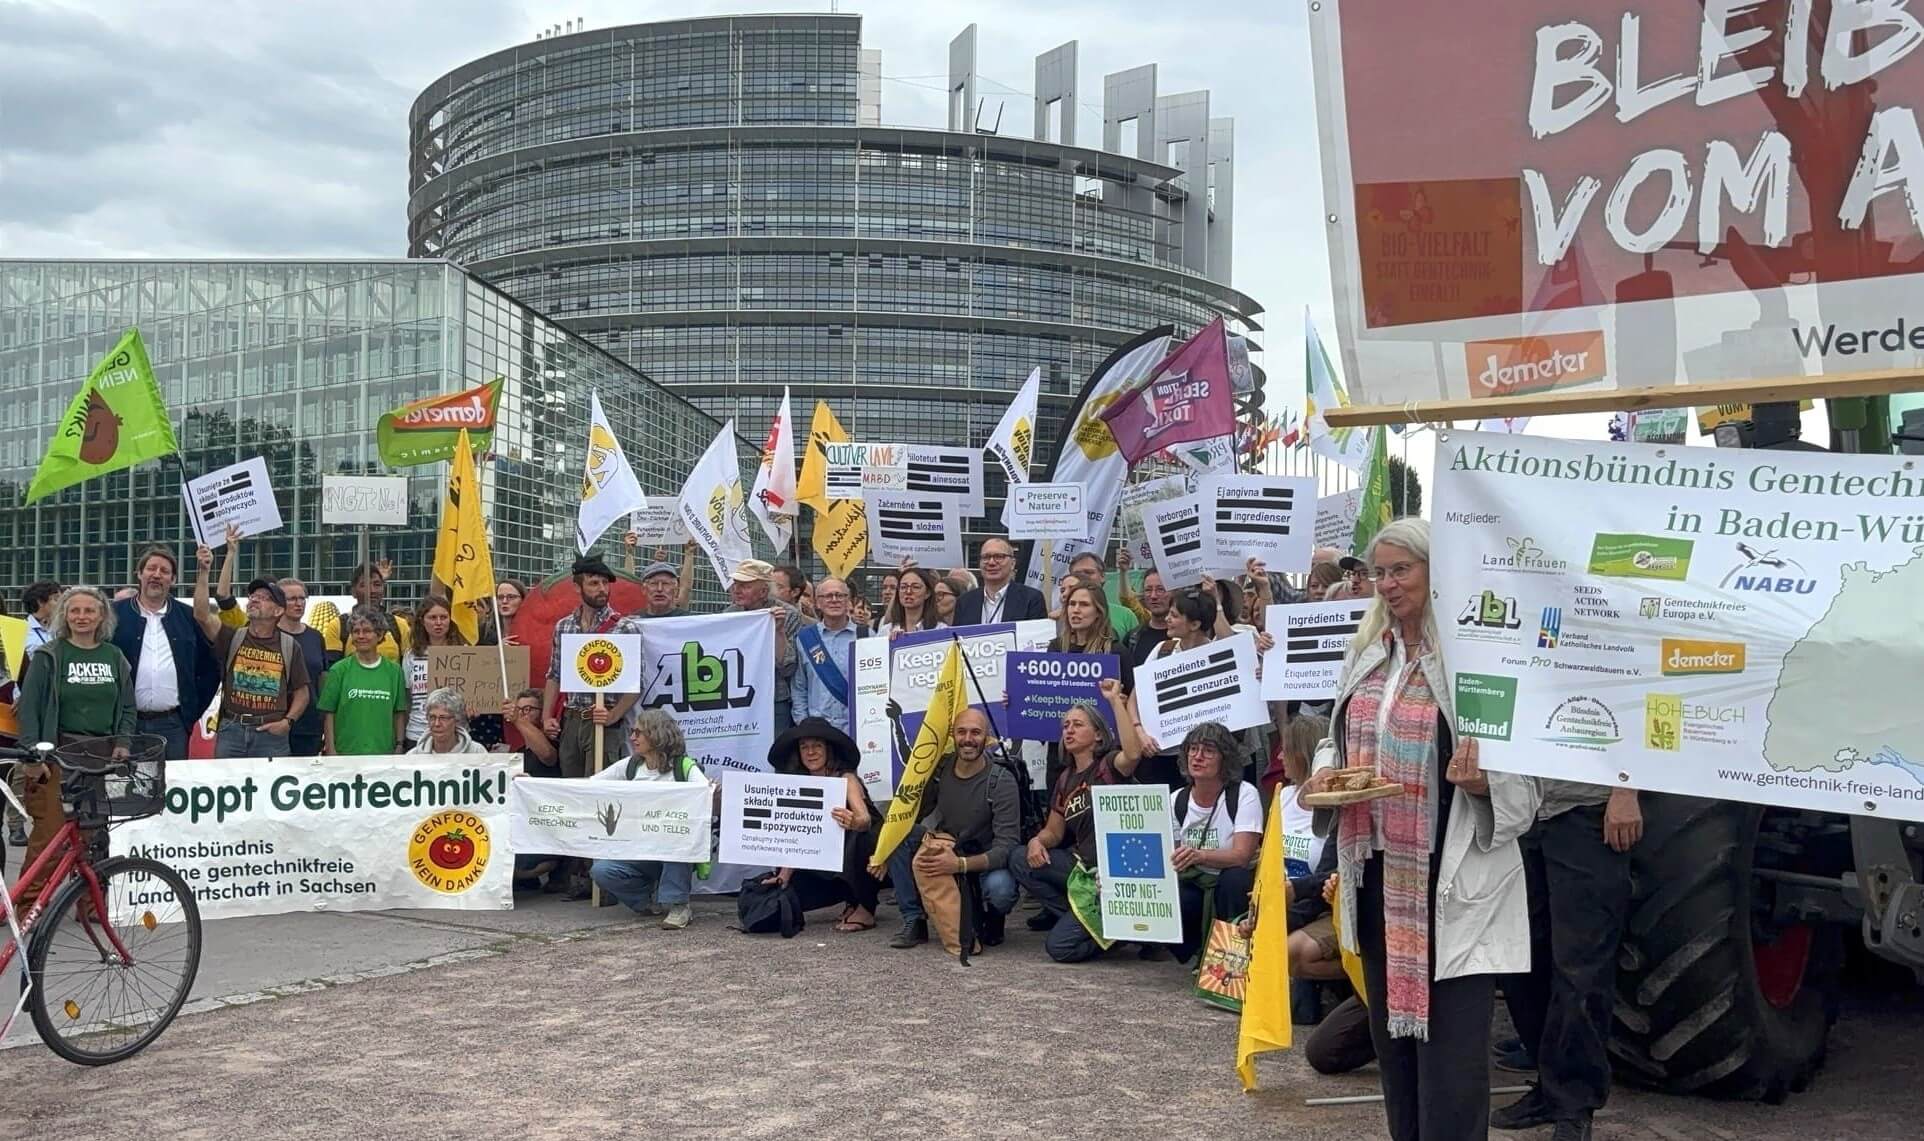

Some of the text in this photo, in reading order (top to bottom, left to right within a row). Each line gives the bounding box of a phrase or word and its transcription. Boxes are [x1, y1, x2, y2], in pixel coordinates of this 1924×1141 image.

[1522, 130, 1792, 267] VOM
[1381, 231, 1491, 257] BIO-VIELFALT
[1376, 261, 1409, 281] STATT
[1478, 348, 1590, 391] demeter
[1449, 443, 1735, 491] Aktionsbündnis
[932, 474, 970, 485] ainesosat
[219, 489, 255, 506] produktów
[1027, 491, 1069, 501] Preserve
[1226, 486, 1260, 498] angivna
[214, 499, 257, 518] spożywczych
[1028, 501, 1062, 511] Nature
[1155, 506, 1194, 523] Verborgen
[1233, 511, 1291, 524] ingredienser
[1445, 511, 1501, 525] Mitglieder:
[1663, 504, 1703, 534] in
[1482, 554, 1567, 569] Land Frauen
[1573, 585, 1602, 595] SEEDS
[1733, 575, 1818, 595] NABU
[1573, 597, 1609, 606] ACTION
[1663, 597, 1747, 612] Gentechnikfreies
[1287, 612, 1346, 626] Ingrédients
[1573, 607, 1621, 619] NETWORK
[1662, 608, 1696, 620] Europa
[1560, 631, 1589, 641] Verband
[578, 639, 623, 658] GENFOOD?
[1559, 640, 1635, 653] Katholisches Landvolk
[435, 652, 478, 672] NGT
[899, 640, 1007, 671] Keep MOs
[1501, 656, 1527, 666] Forum
[1667, 647, 1736, 669] demeter
[577, 666, 623, 688] NEIN DANKE
[641, 640, 756, 713] AbL
[1016, 659, 1103, 680] +600,000
[1153, 658, 1207, 682] Ingrediente
[1322, 668, 1334, 677] les
[1191, 674, 1240, 693] cenzurate
[1283, 679, 1338, 690] nouveaux OGM
[1031, 694, 1098, 707] Keep the labels
[1027, 708, 1045, 721] Say
[1646, 699, 1745, 722] HOHEBUCH
[686, 721, 760, 737] Landwirtschaft e.V.
[1457, 715, 1509, 737] Bioland
[700, 753, 761, 773] the Bauer
[269, 768, 508, 813] Gentechnik!
[743, 783, 797, 797] Usunięte ze
[1717, 768, 1924, 801] www.gentechnik-freie-land
[537, 805, 565, 814] KEINE
[743, 797, 774, 807] składu
[1099, 795, 1141, 813] PROTECT
[1143, 795, 1164, 812] OUR
[644, 810, 689, 820] AUF ACKER
[774, 810, 823, 823] produktów
[1119, 813, 1145, 830] FOOD
[412, 812, 490, 846] GENFOOD?
[641, 824, 691, 835] UND TELLER
[762, 821, 823, 836] spożywczych
[1281, 835, 1312, 849] PROTECT
[128, 840, 275, 862] Aktionsbündnis
[206, 857, 355, 886] gentechnikfreie
[412, 856, 488, 892] NEIN DANKE
[128, 877, 377, 906] Landirtschaft in Sachsen
[1114, 882, 1163, 899] STOP NGT-
[1107, 900, 1173, 919] DEREGULATION
